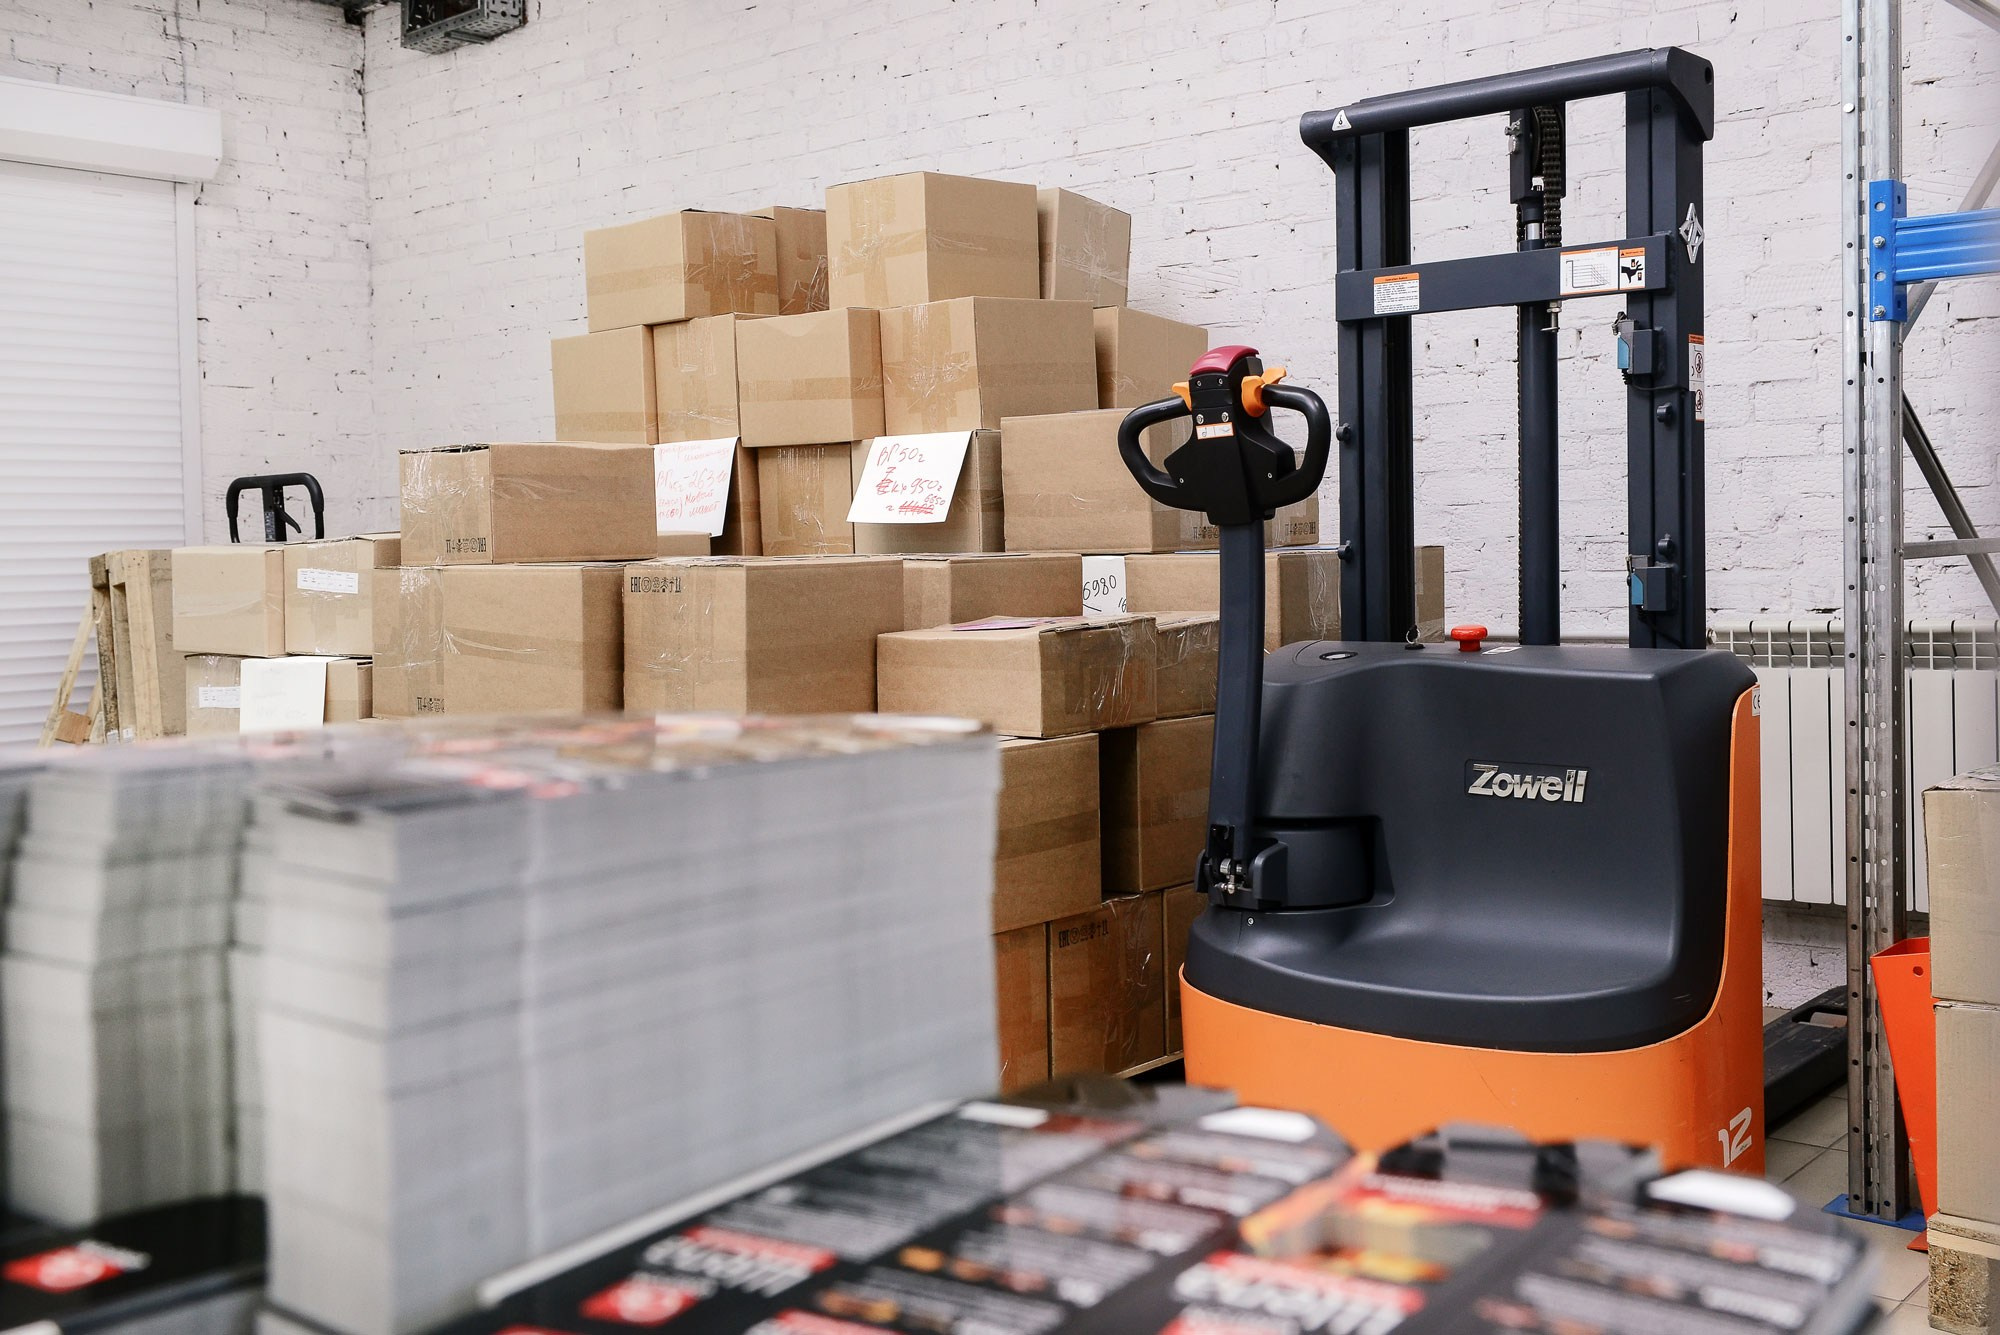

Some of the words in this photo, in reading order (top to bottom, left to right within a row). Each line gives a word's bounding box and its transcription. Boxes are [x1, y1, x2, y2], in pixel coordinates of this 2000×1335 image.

[1083, 574, 1117, 601] 6980
[1468, 763, 1588, 803] Zowell
[1718, 1106, 1753, 1168] 12
